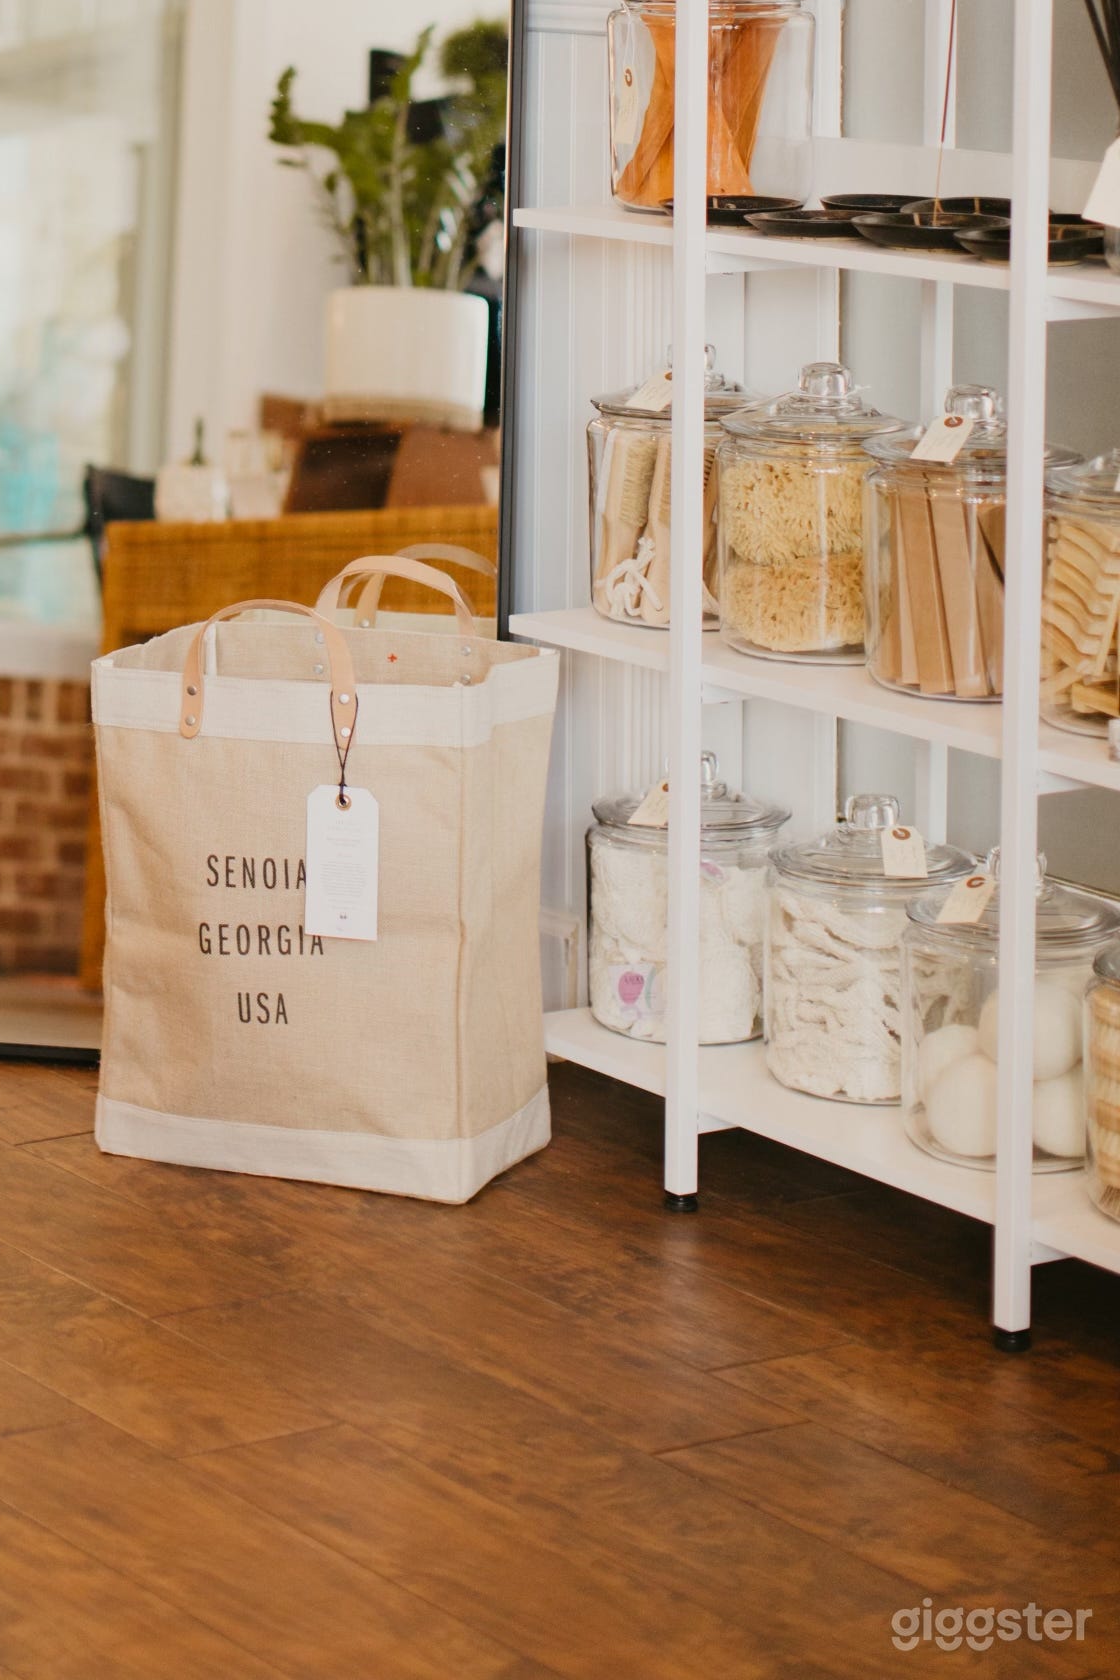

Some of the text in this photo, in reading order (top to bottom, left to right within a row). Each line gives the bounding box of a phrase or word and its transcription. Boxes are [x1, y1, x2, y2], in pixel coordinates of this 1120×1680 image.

[206, 854, 307, 889] SENOIA
[199, 922, 324, 956] GEORGIA
[237, 992, 289, 1025] USA
